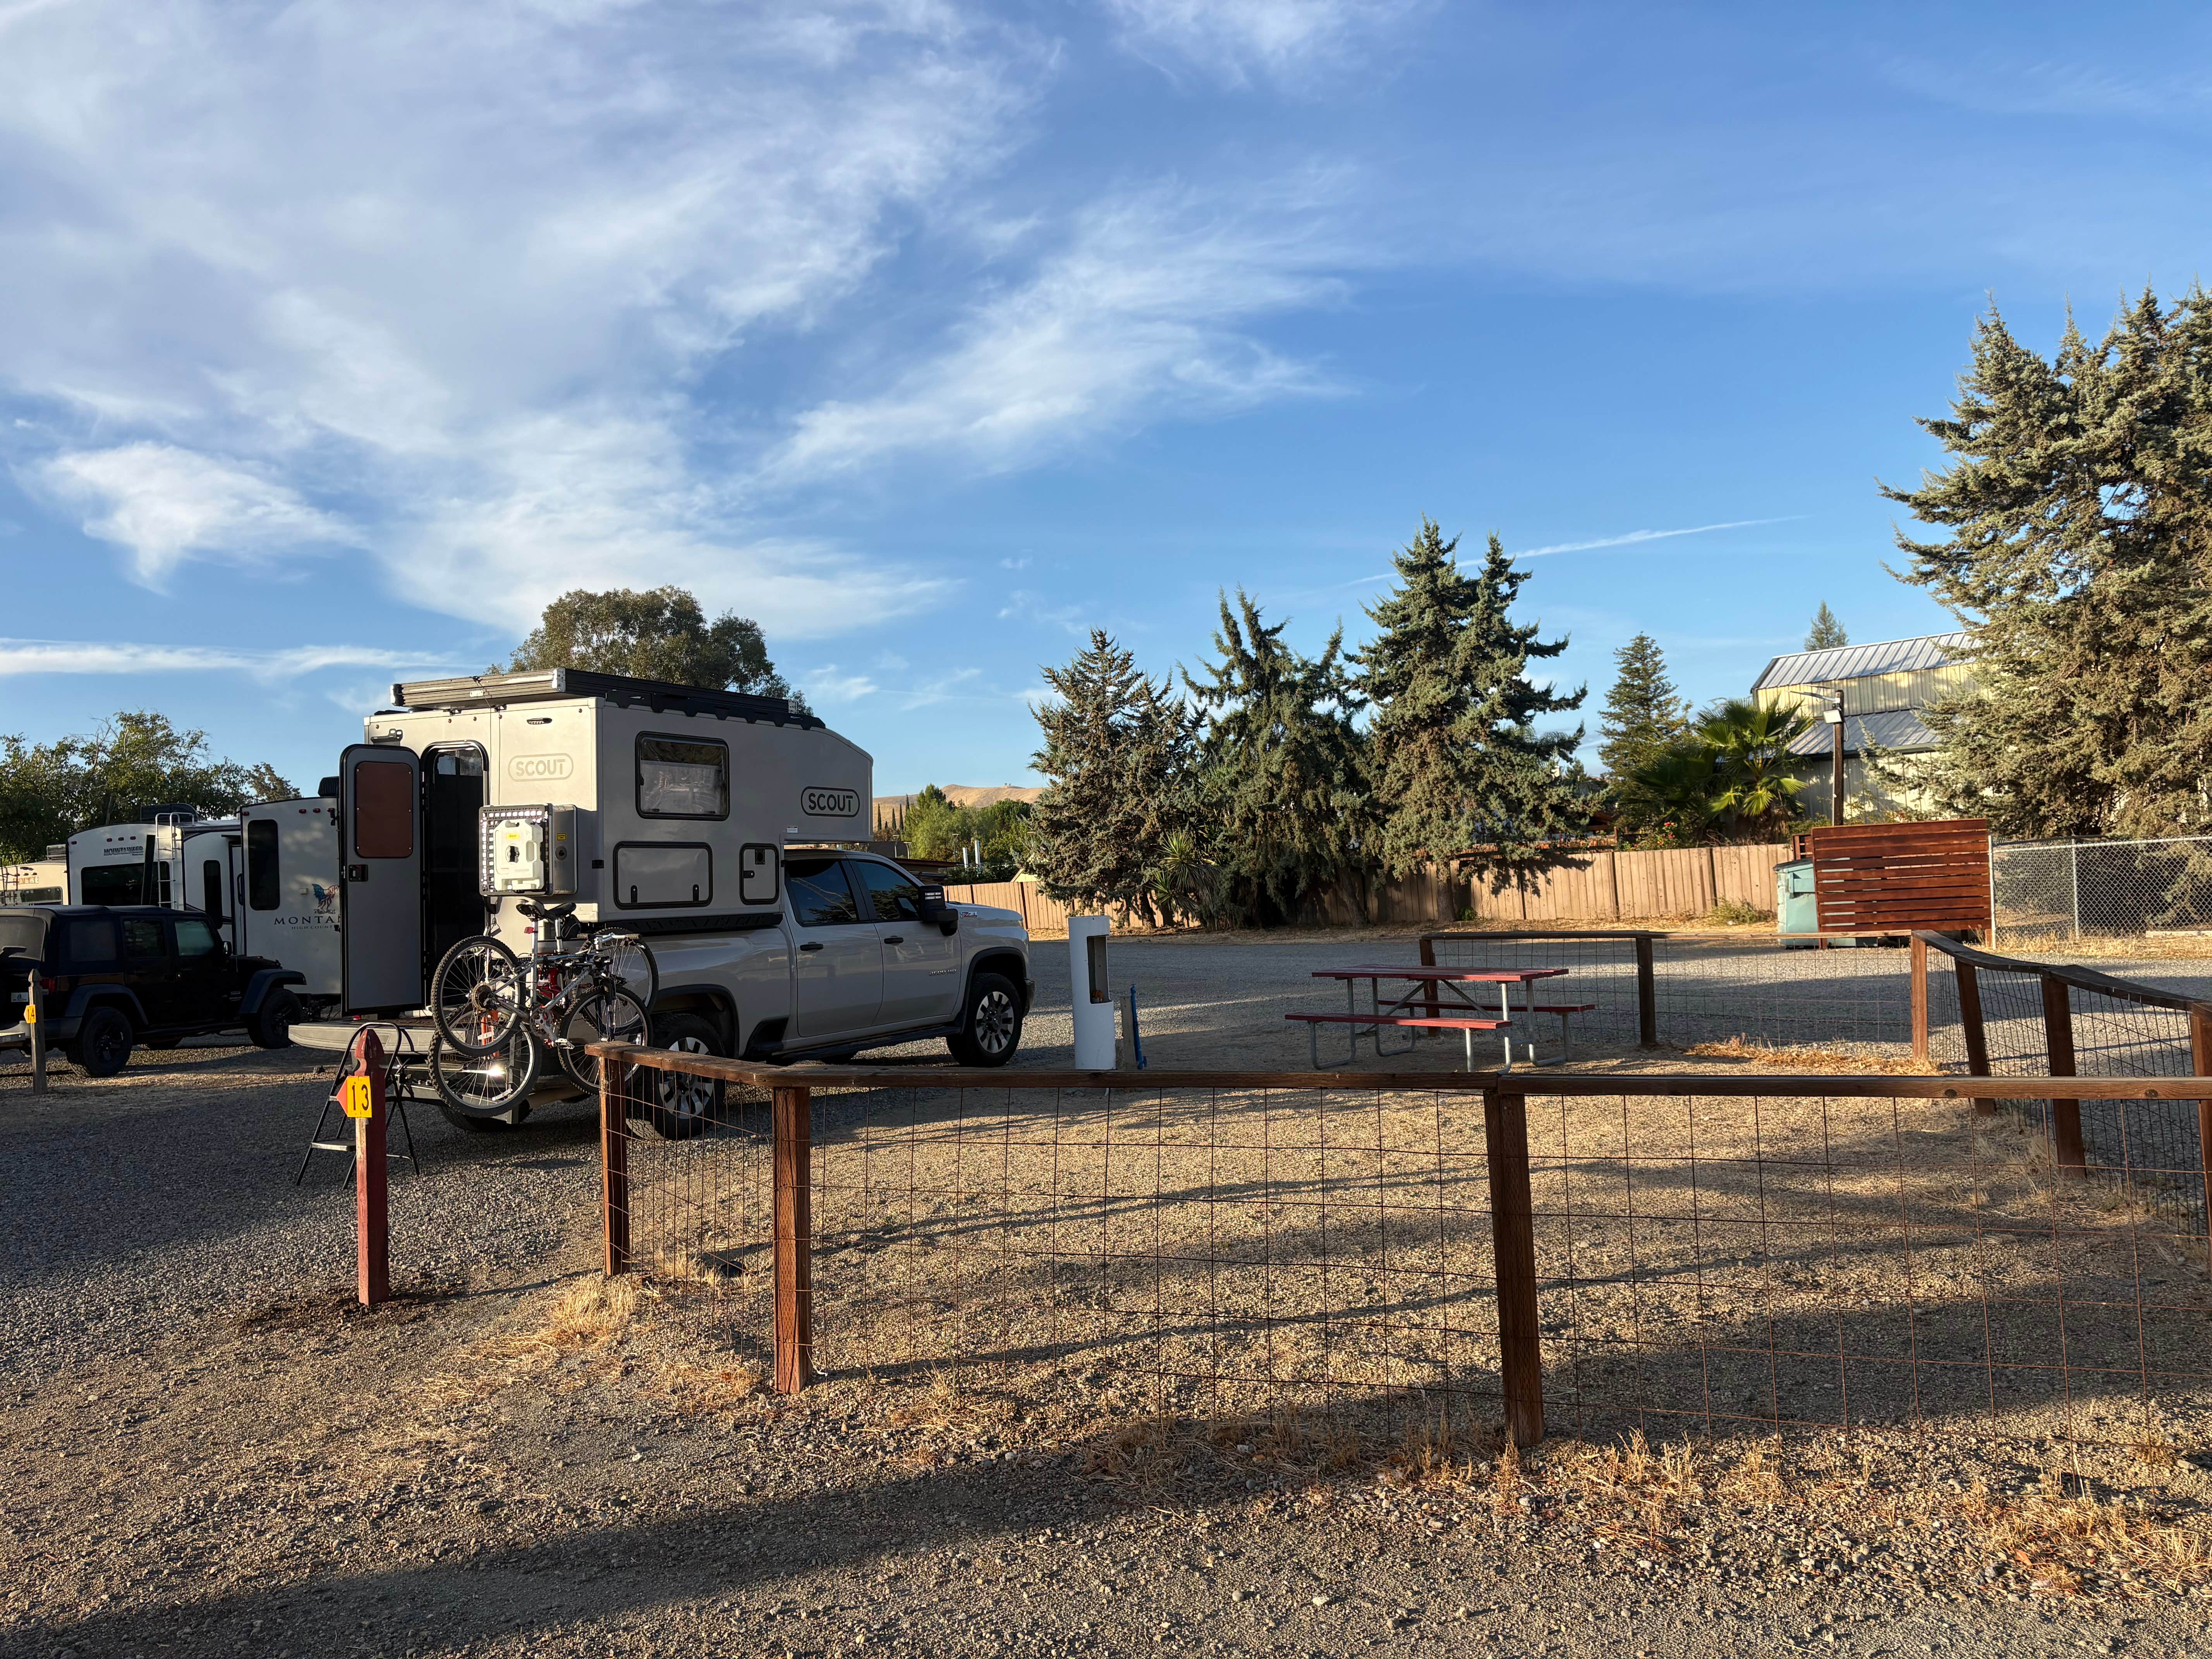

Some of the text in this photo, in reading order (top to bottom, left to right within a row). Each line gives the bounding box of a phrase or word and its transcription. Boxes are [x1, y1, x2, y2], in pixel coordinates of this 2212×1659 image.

[516, 759, 565, 776] SCOUT
[809, 793, 853, 812] SCOUT
[27, 1008, 35, 1020] 14
[352, 1084, 369, 1111] 13
